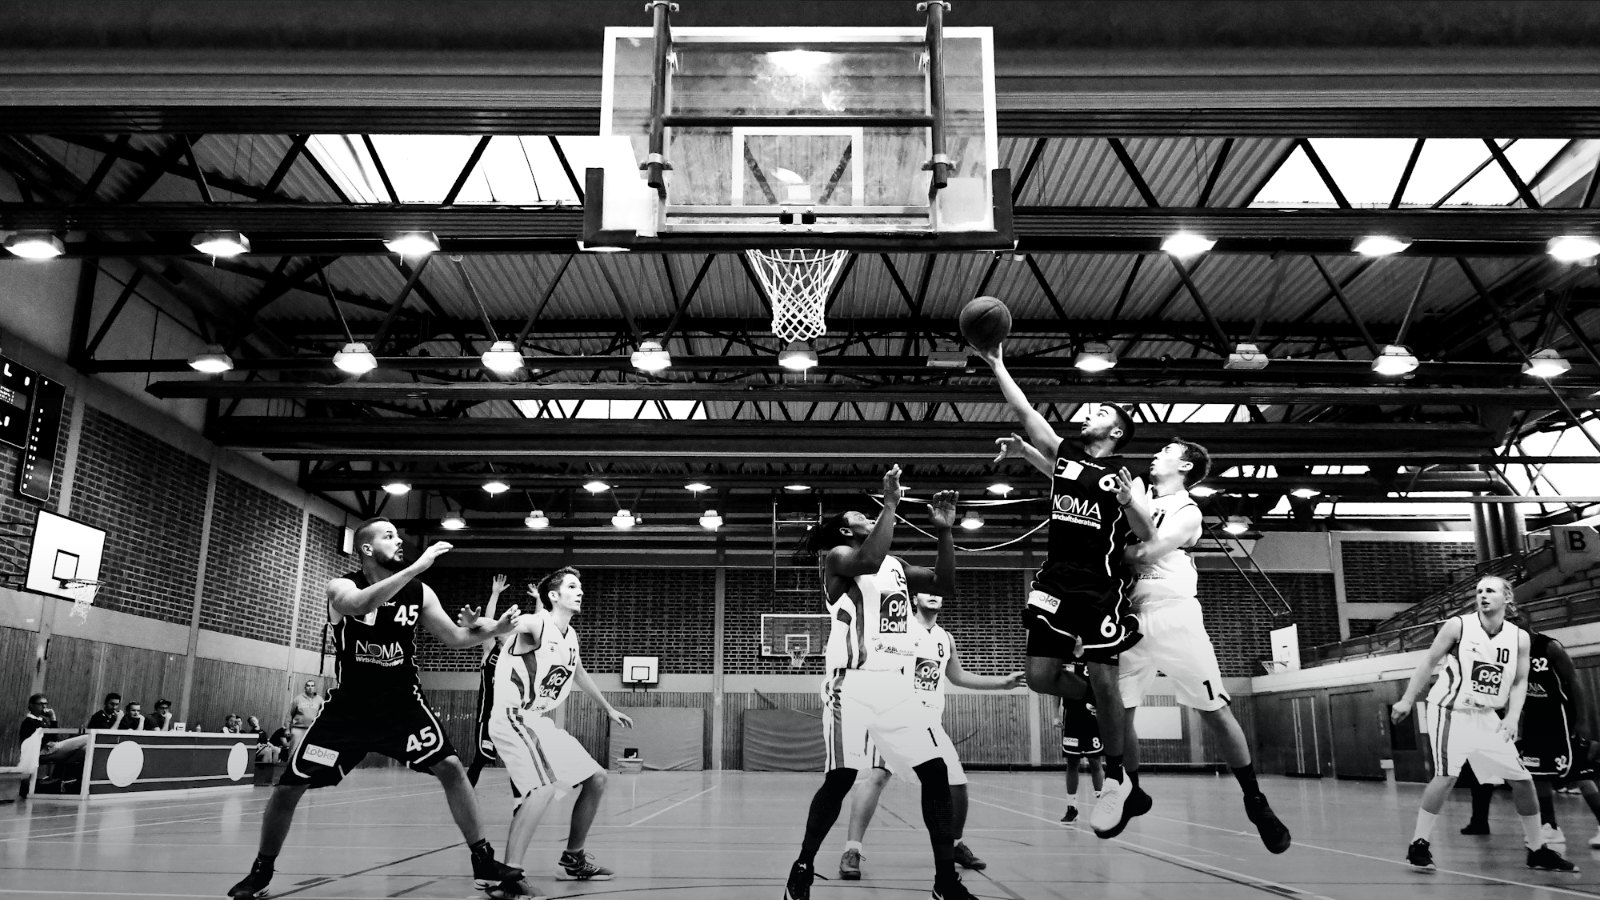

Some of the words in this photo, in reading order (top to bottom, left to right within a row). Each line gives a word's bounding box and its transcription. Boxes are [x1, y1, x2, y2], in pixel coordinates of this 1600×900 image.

[1099, 474, 1117, 491] 6
[1052, 494, 1101, 519] NOMA
[1568, 531, 1586, 551] B
[394, 605, 419, 626] 45
[881, 618, 907, 632] Bank
[1100, 615, 1117, 638] 6
[355, 640, 404, 659] NOMA
[938, 643, 945, 658] 8
[1497, 648, 1509, 664] 10
[1532, 657, 1549, 672] 32
[540, 685, 558, 699] Bank
[915, 678, 937, 691] Bank
[1472, 680, 1499, 695] Bank
[406, 726, 437, 752] 45
[1092, 737, 1101, 749] 8
[1555, 755, 1568, 771] 32
